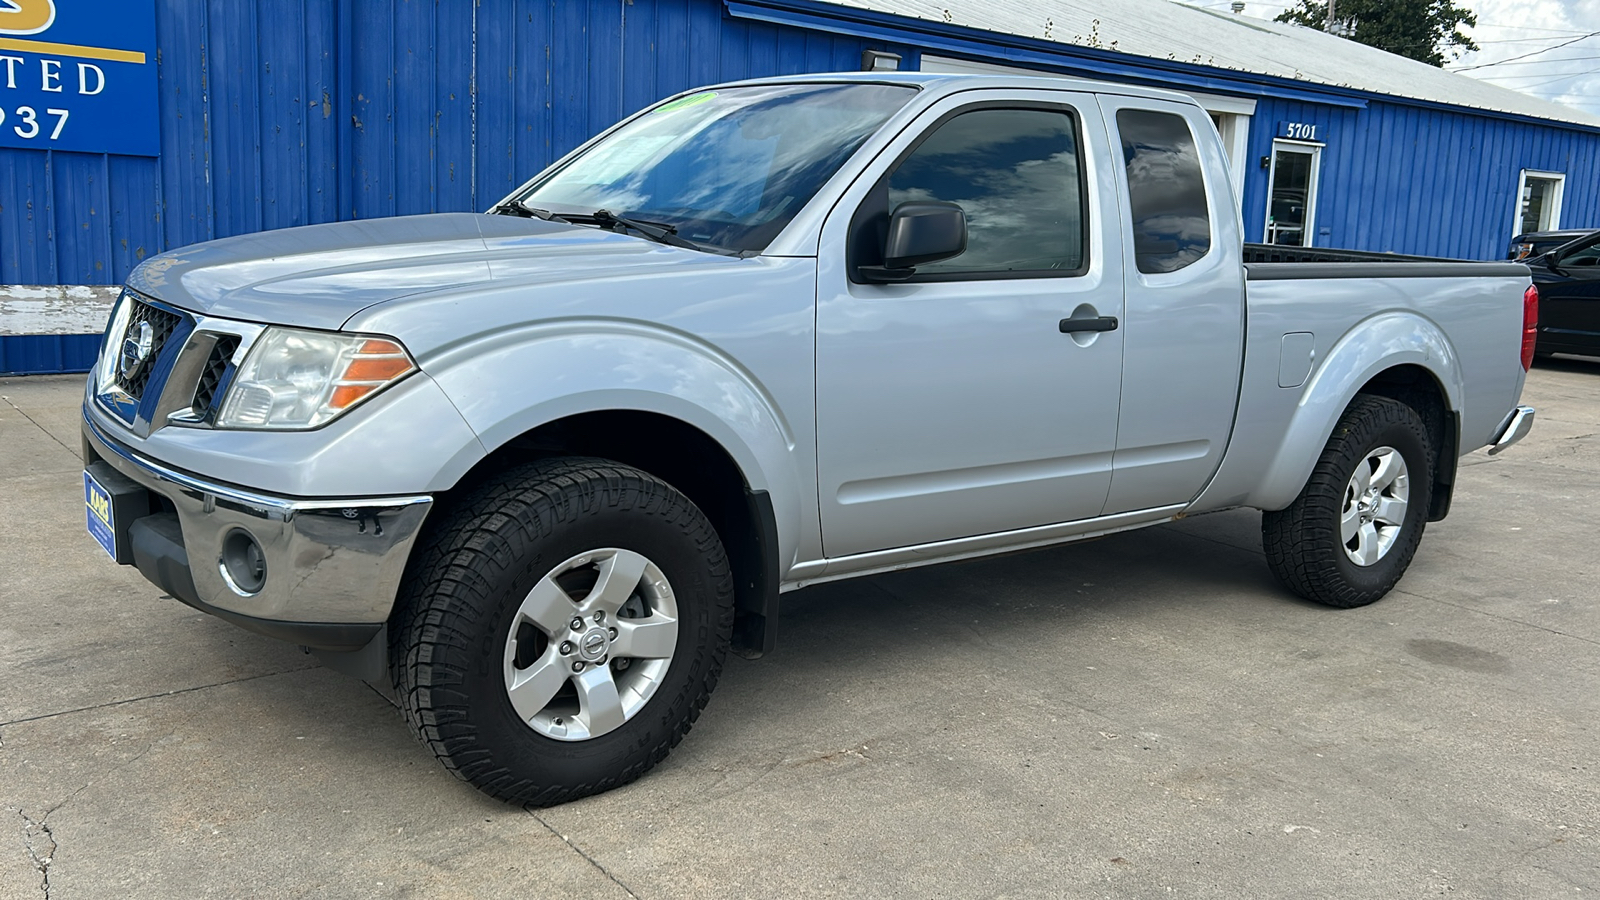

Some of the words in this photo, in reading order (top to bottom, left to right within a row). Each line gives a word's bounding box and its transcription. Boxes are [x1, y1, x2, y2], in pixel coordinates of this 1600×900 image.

[0, 105, 70, 140] 37
[1286, 122, 1316, 140] 5701
[475, 552, 542, 678] COOPER
